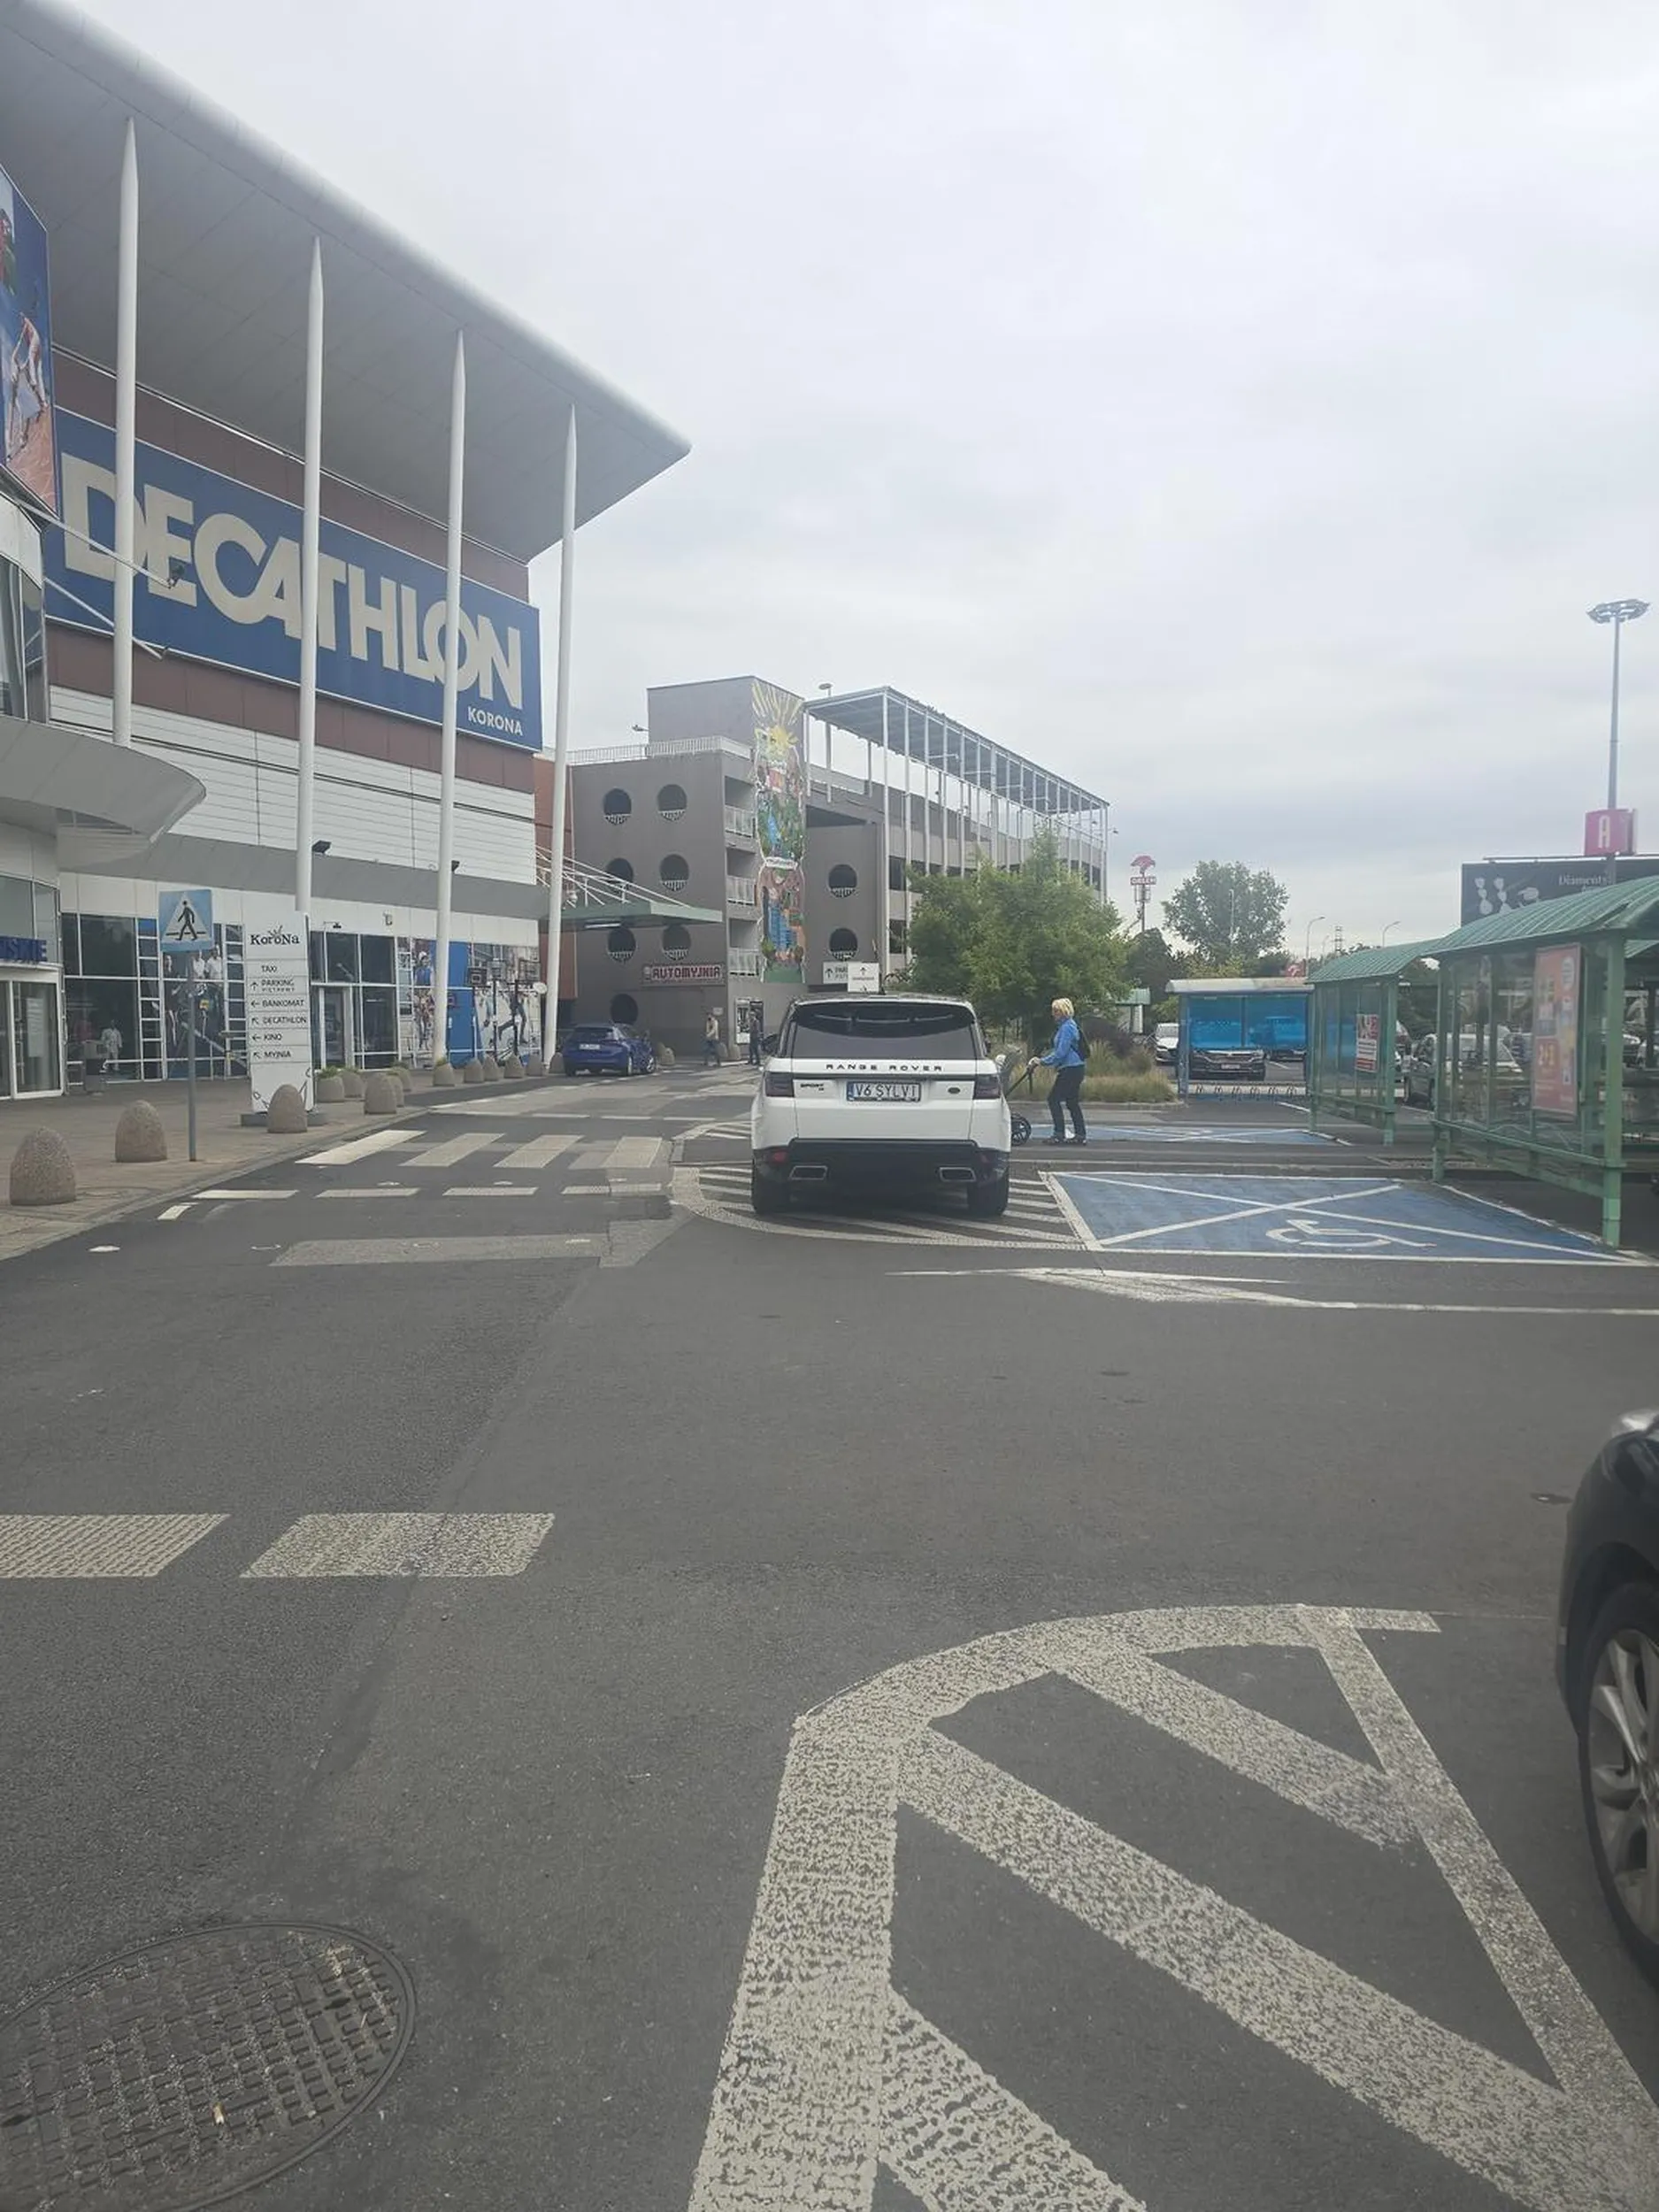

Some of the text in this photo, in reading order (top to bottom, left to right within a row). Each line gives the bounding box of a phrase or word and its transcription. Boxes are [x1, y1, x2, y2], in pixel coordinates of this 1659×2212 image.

[61, 452, 524, 710] DECATHLON
[468, 706, 523, 736] KORONA
[856, 1084, 872, 1096] V6
